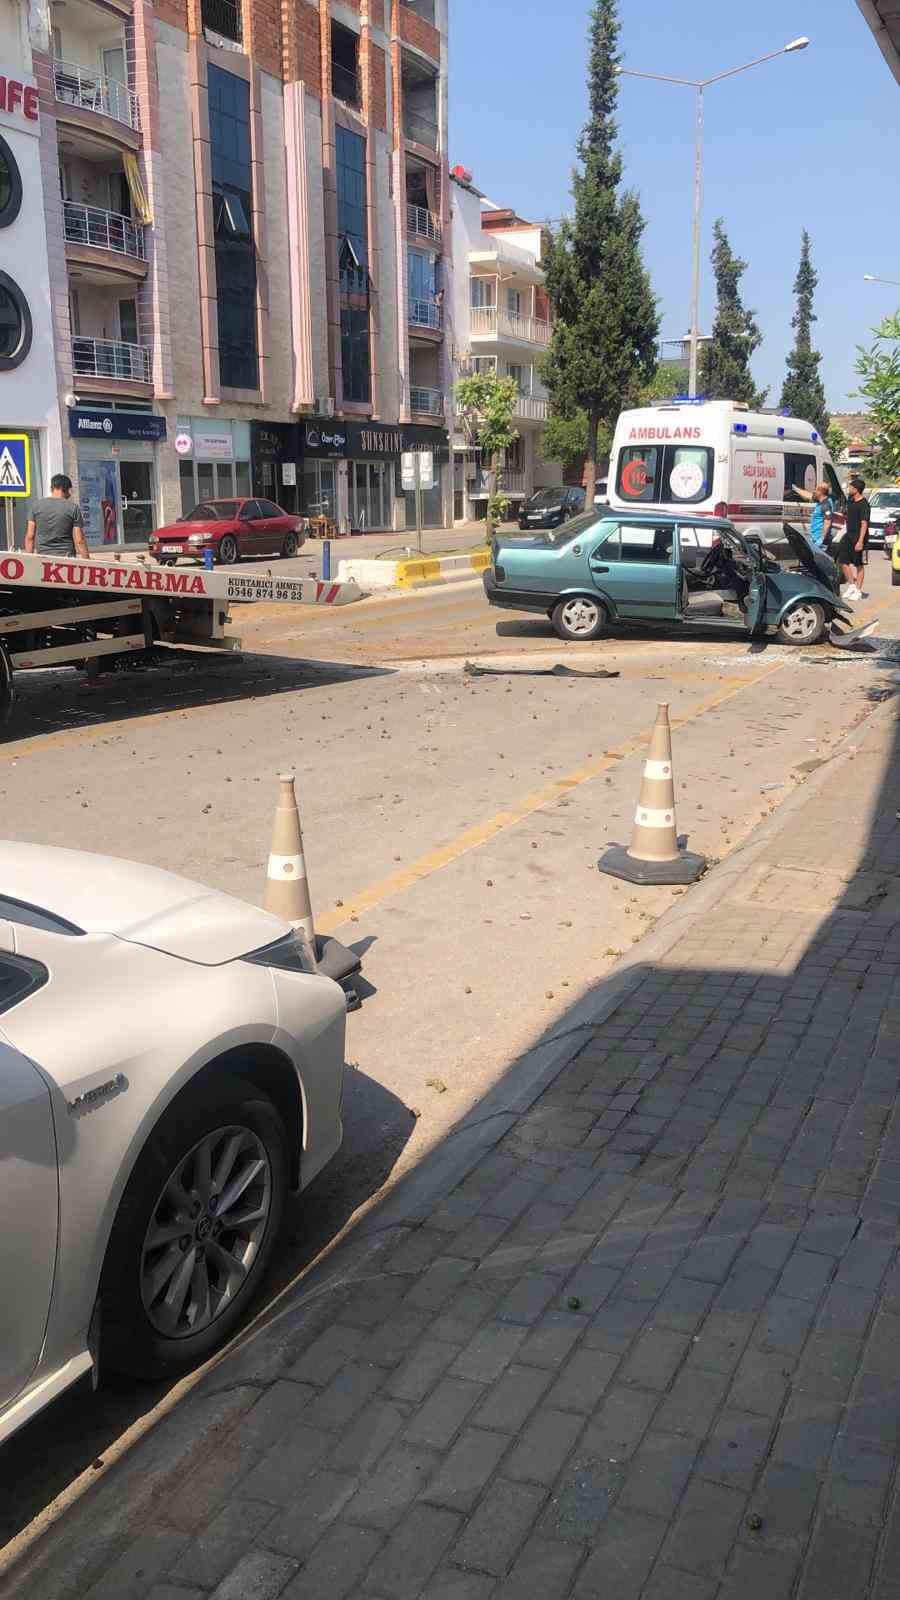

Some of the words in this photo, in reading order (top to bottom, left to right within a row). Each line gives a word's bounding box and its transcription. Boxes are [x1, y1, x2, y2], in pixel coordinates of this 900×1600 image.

[78, 418, 103, 430] Allianz
[628, 426, 701, 440] AMBULANS
[752, 480, 769, 499] 112
[41, 561, 207, 594] KURTARMA
[228, 577, 273, 589] KURTARICI
[275, 581, 304, 591] AHMET
[227, 586, 253, 597] 0546
[255, 588, 273, 599] 874
[276, 590, 288, 600] 96
[290, 591, 302, 601] 23
